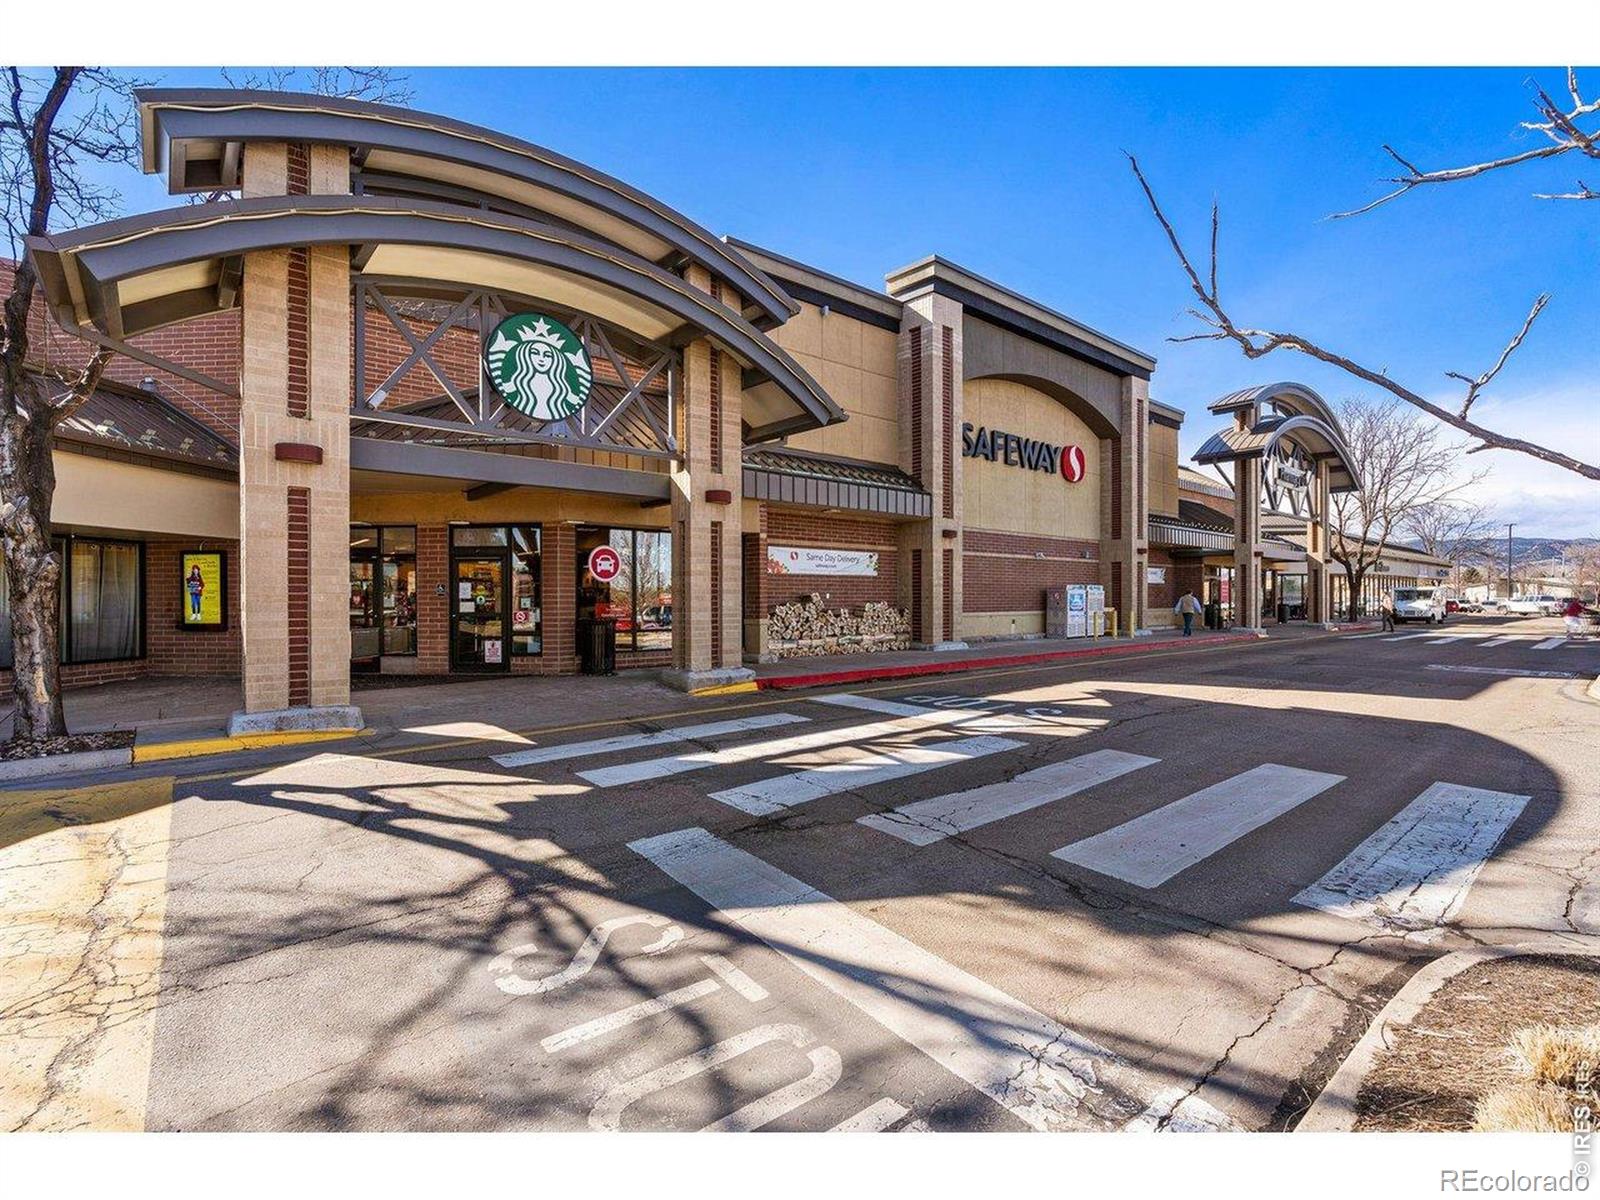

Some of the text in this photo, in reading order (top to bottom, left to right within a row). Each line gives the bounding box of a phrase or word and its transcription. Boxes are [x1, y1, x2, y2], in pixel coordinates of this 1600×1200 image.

[962, 422, 1062, 475] SAFEWAY
[806, 552, 860, 565] Same Day Delivery
